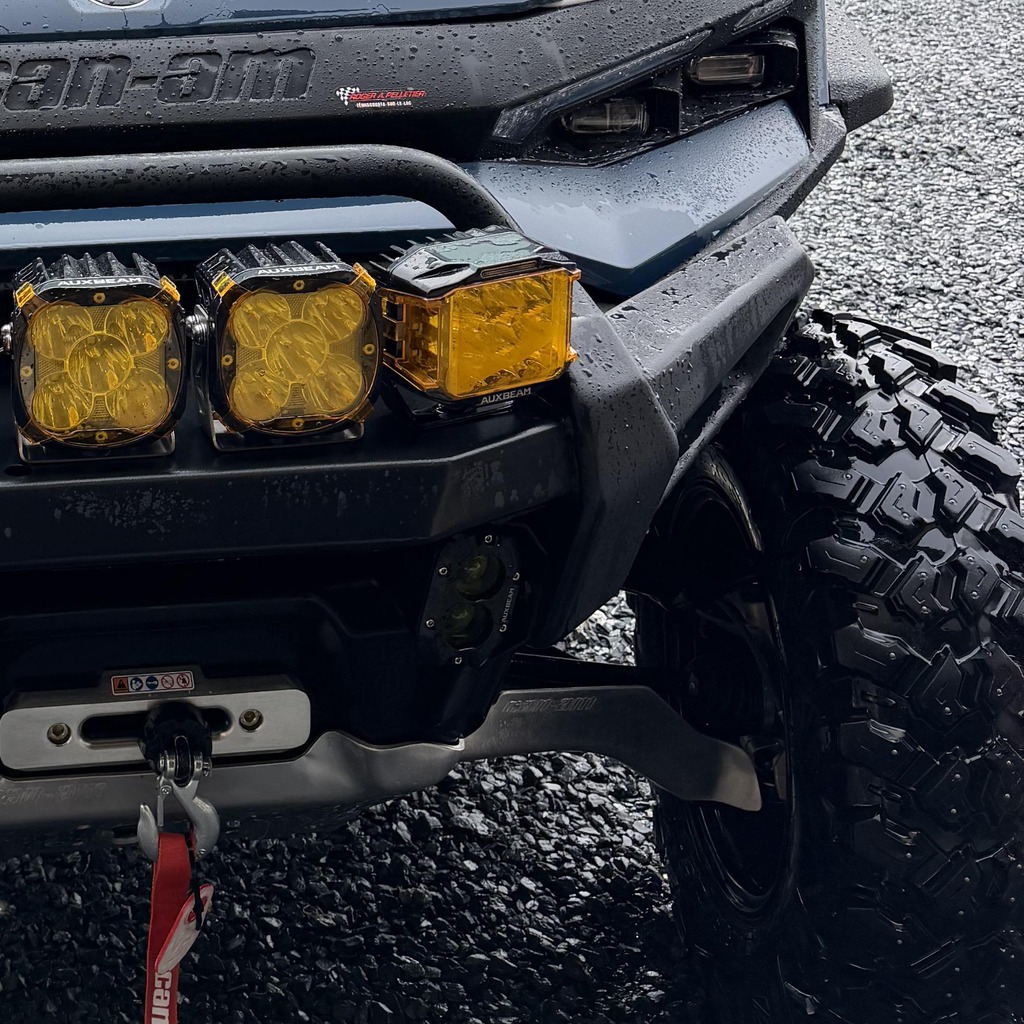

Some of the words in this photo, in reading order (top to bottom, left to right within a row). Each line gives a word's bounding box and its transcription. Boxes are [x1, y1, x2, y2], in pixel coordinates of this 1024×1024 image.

[385, 90, 426, 98] PELLETIER
[258, 264, 340, 275] AUXBEAM
[57, 277, 142, 286] AUXBEAM
[480, 387, 532, 405] AUXBEAM
[501, 588, 515, 623] AUXBEAM
